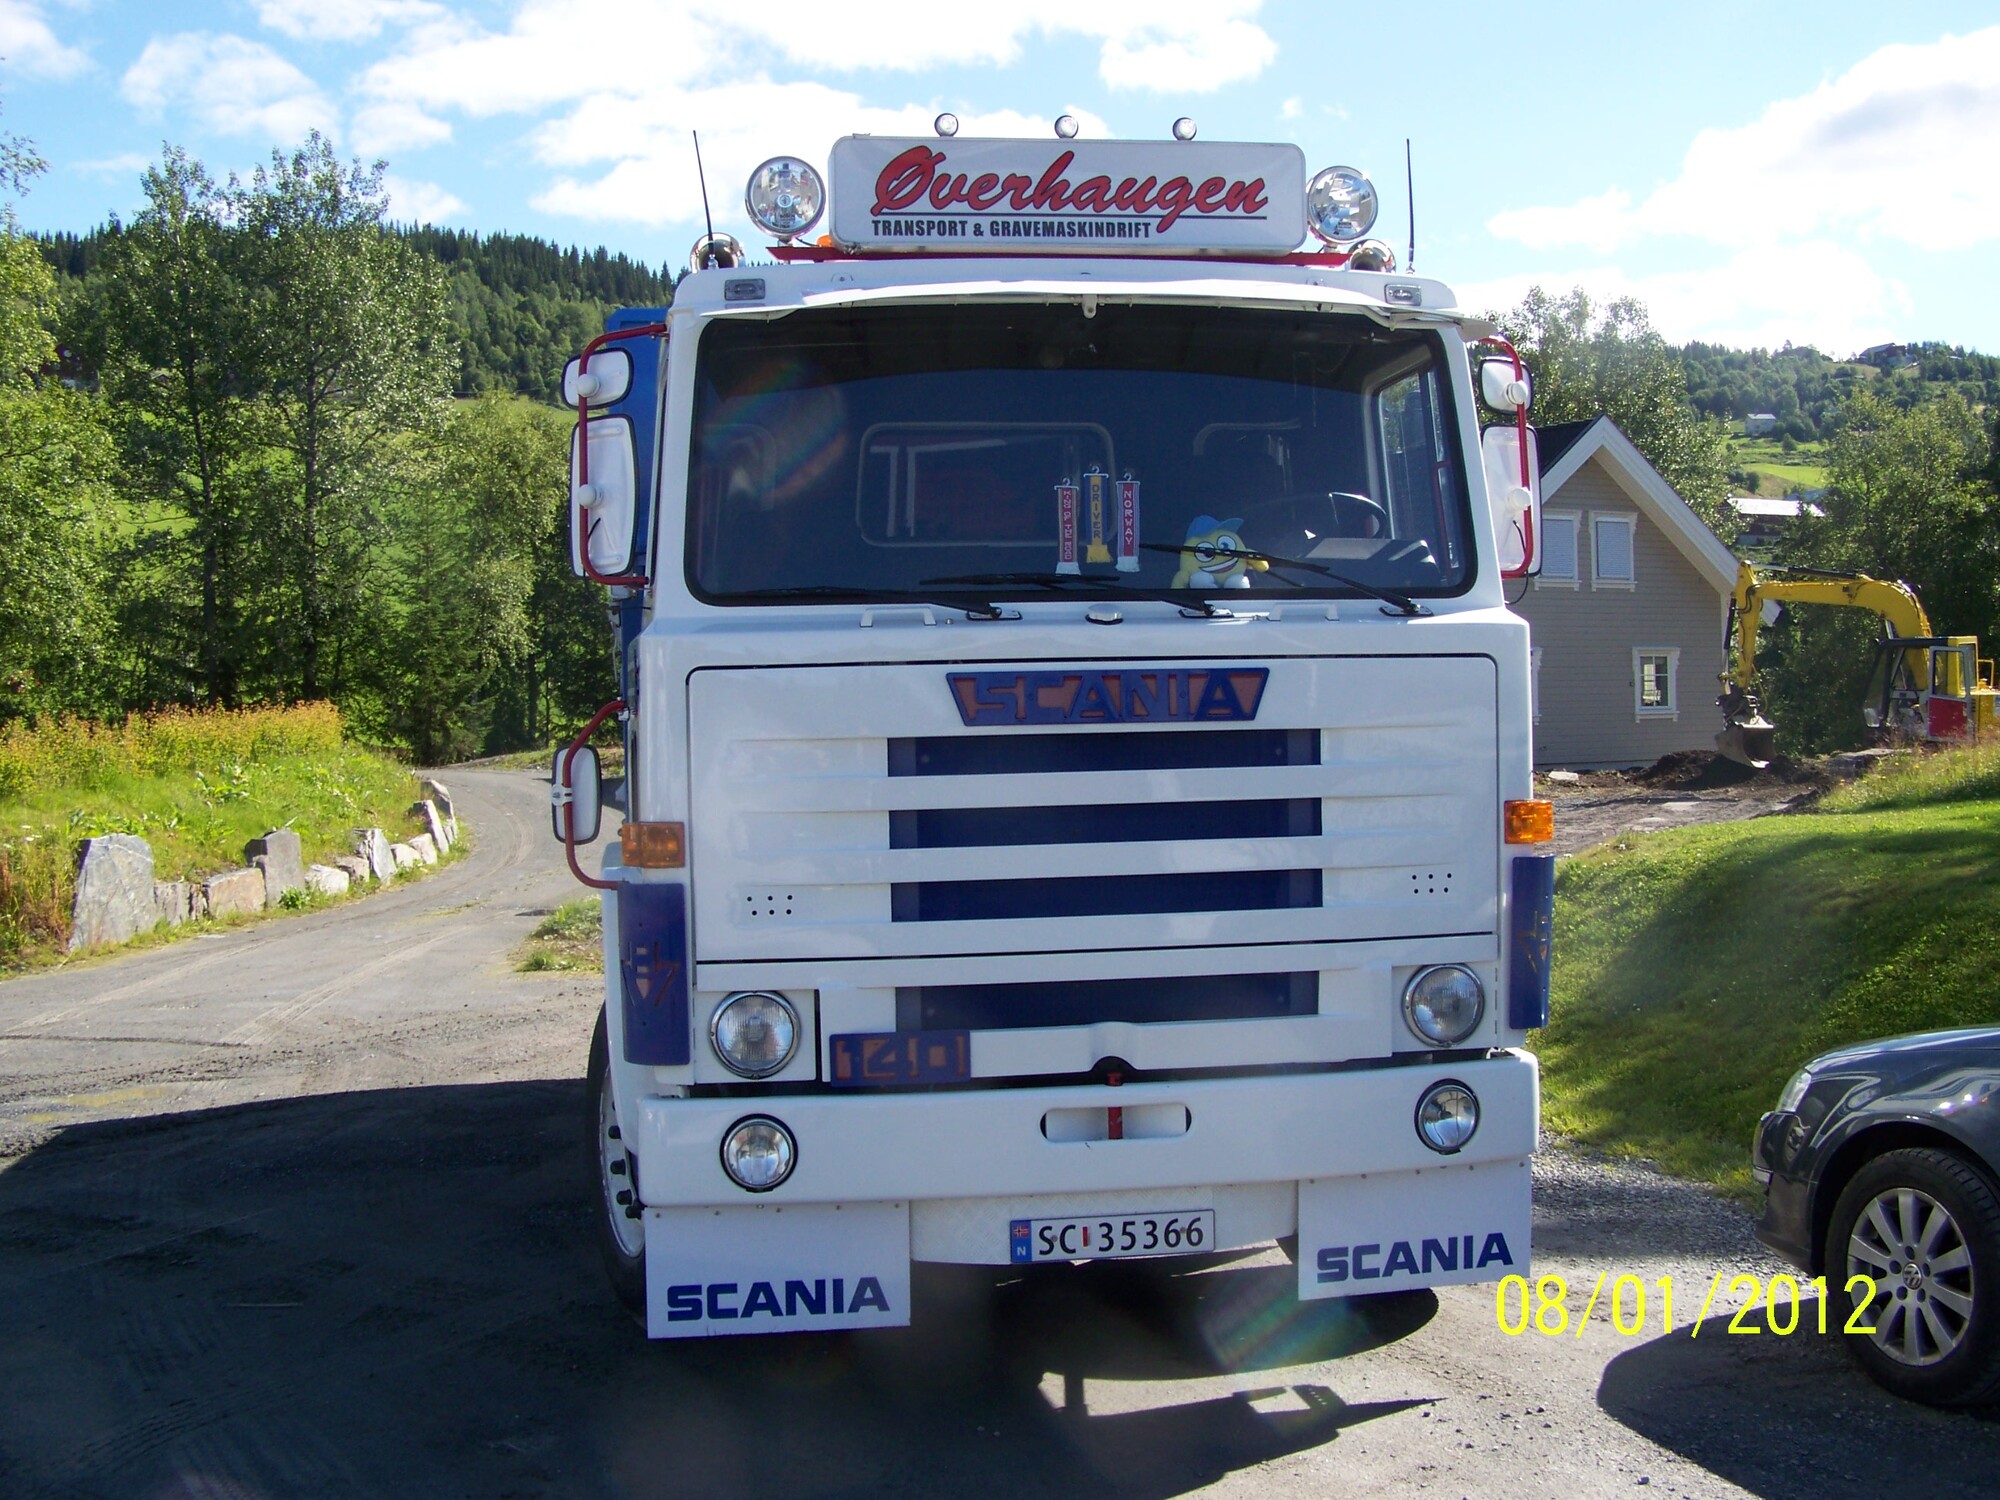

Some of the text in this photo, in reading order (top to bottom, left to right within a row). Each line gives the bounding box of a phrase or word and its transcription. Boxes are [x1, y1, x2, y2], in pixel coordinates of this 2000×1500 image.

[870, 145, 1269, 234] Øverhaugen
[872, 219, 1151, 238] TRANSPORT & GRAVEMASKINDRIFT
[1092, 484, 1101, 539] DRIVER
[1123, 490, 1133, 545] NORWAY
[963, 669, 1250, 723] SCANIA
[1016, 1246, 1026, 1256] N
[1098, 1216, 1204, 1252] 35366
[1316, 1232, 1514, 1284] SCANIA
[667, 1276, 890, 1322] SCANIA
